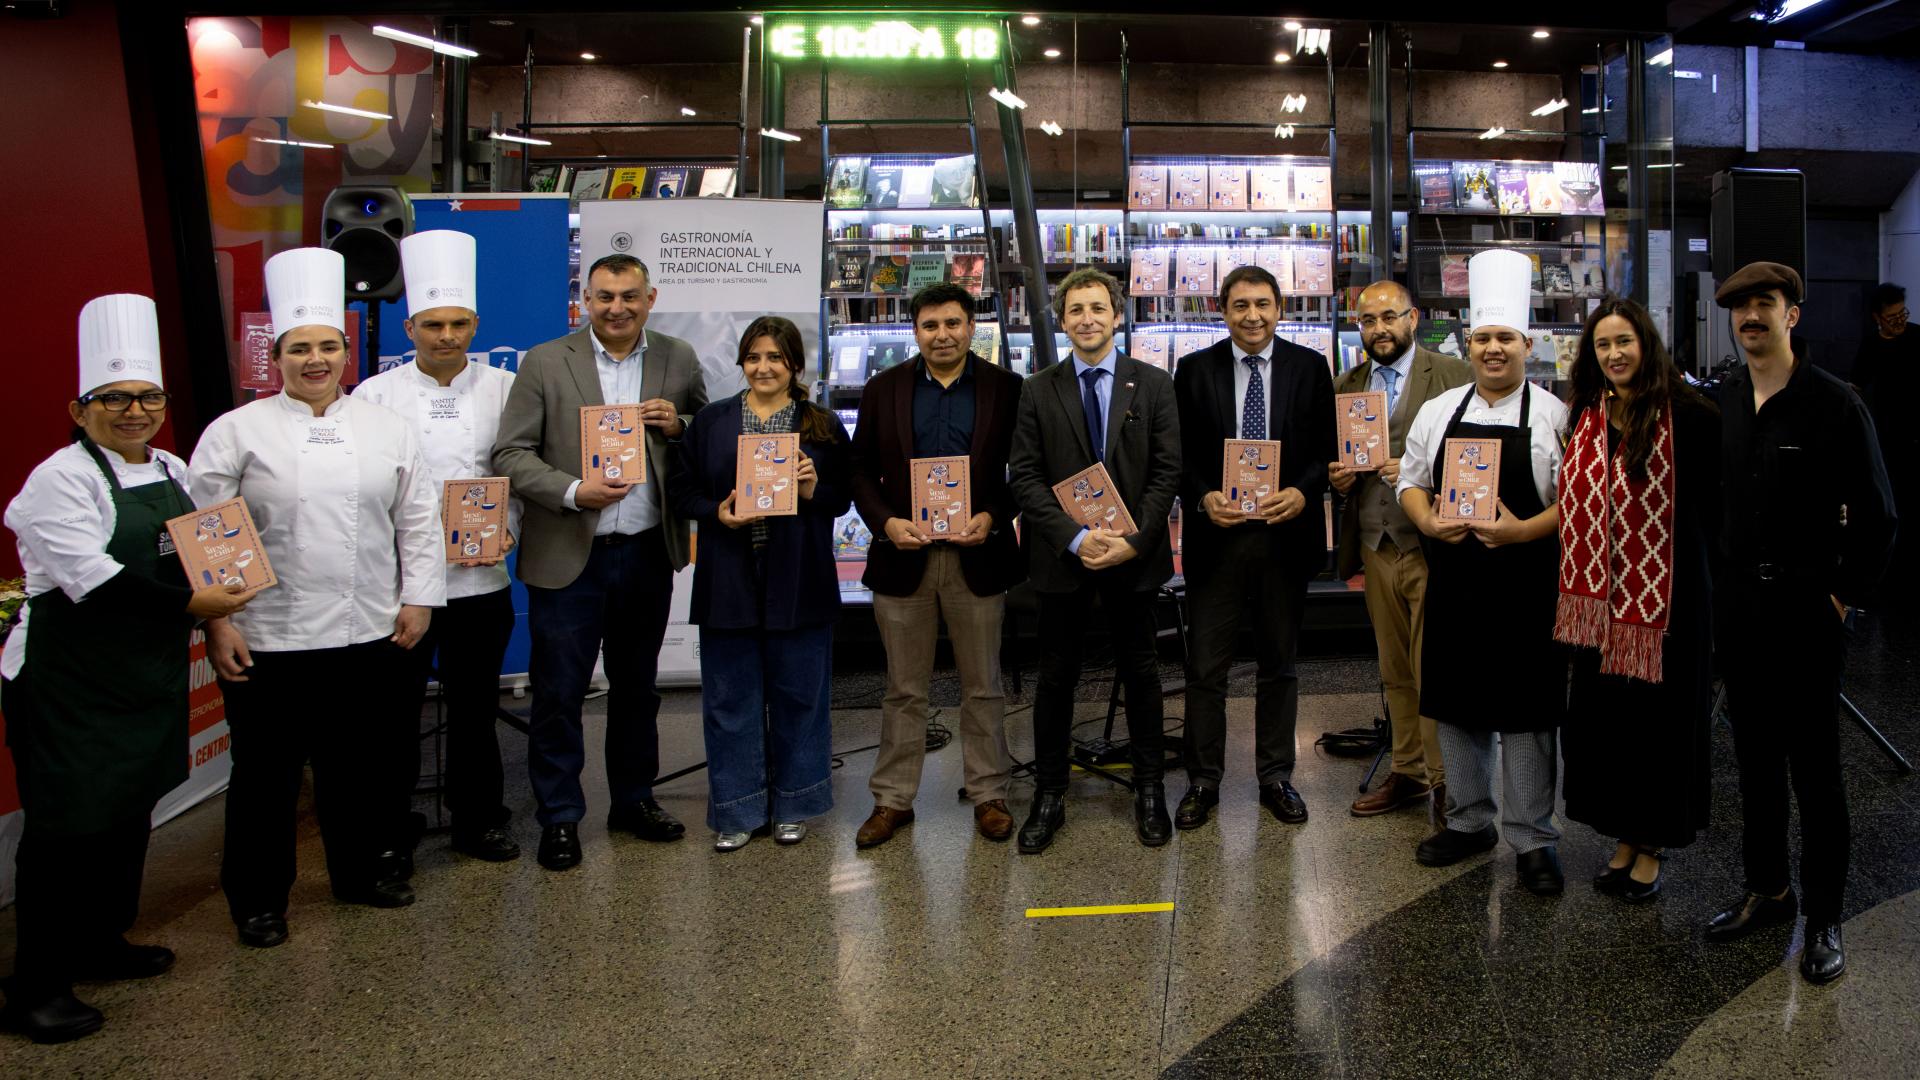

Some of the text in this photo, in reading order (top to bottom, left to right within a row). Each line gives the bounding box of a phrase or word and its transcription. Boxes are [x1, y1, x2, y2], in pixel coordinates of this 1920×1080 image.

[917, 27, 946, 59] A
[956, 27, 998, 59] 18
[660, 229, 753, 244] GASTRONOMÍA
[660, 247, 773, 259] INTERNACIONAL Y
[660, 262, 801, 274] TRADICIONAL CHILENA
[195, 733, 230, 768] CENTRO
